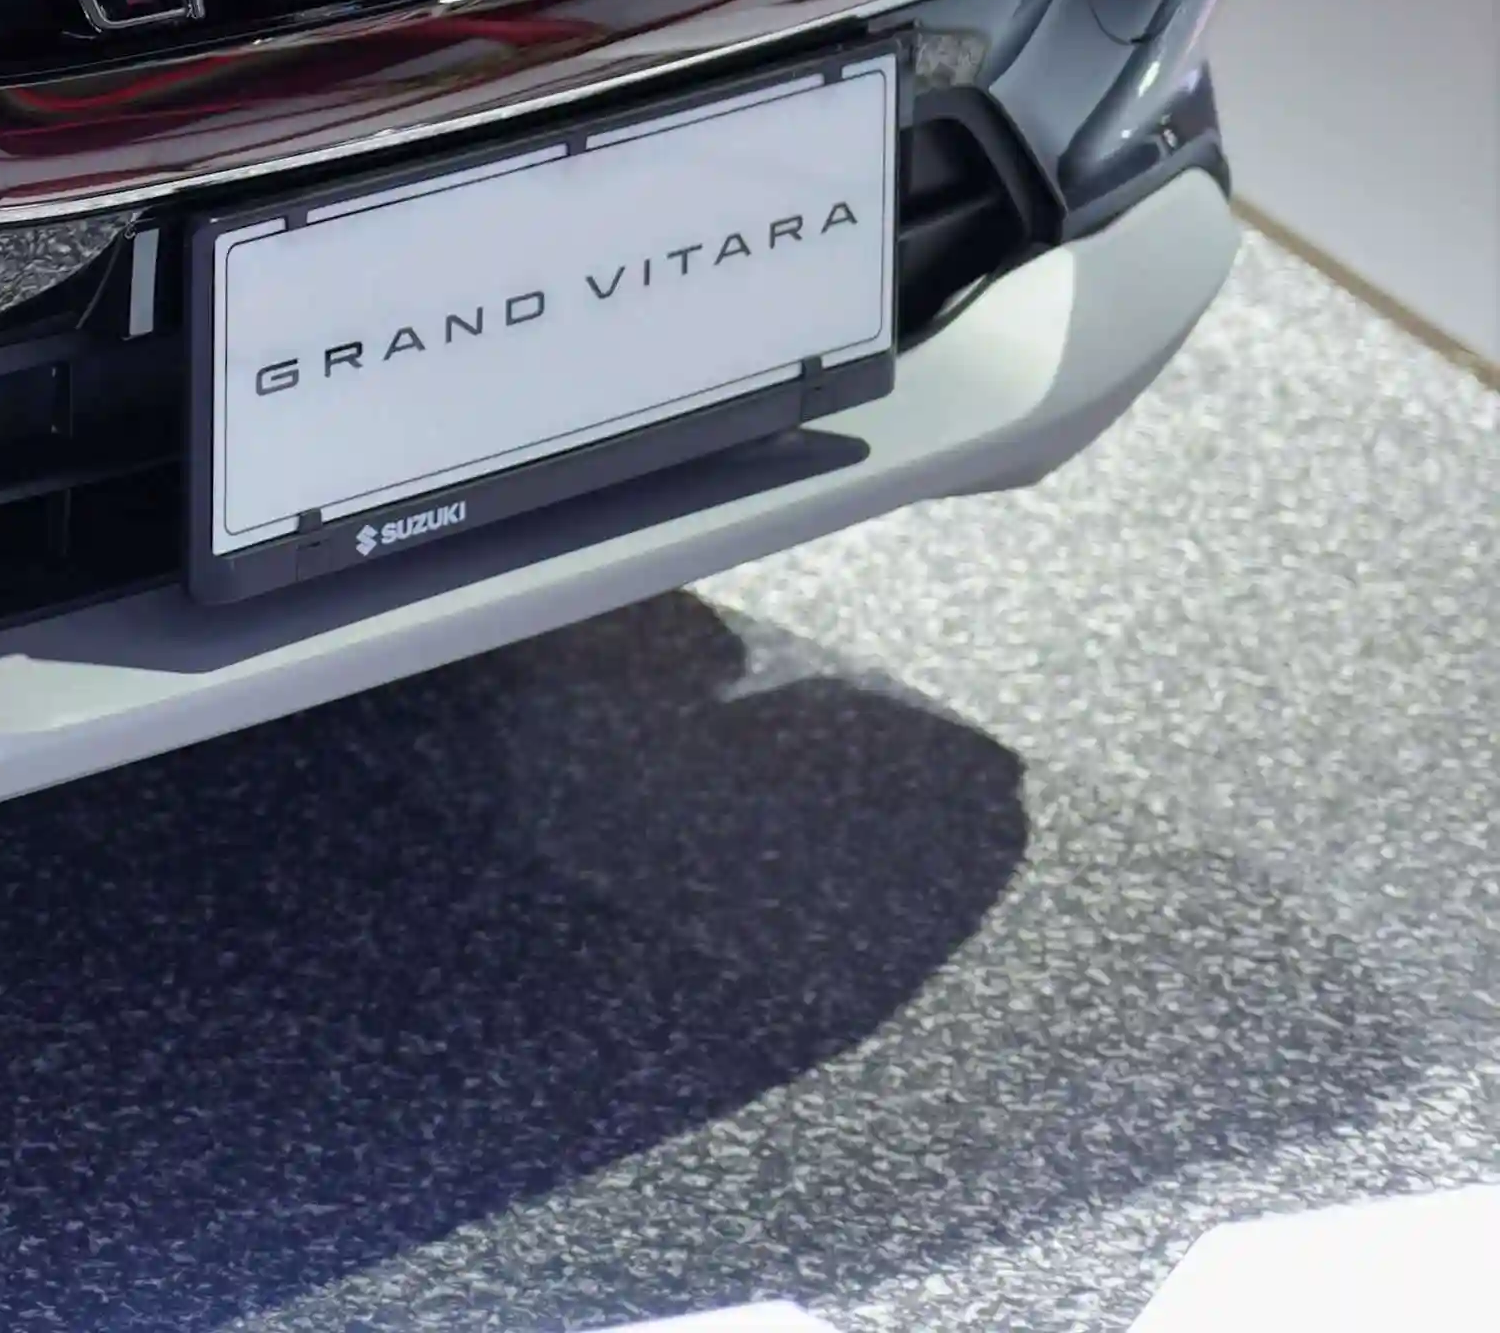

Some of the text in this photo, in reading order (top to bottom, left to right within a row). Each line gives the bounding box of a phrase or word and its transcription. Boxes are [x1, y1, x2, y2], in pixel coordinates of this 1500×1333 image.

[254, 199, 860, 397] GRAND VITARA
[380, 500, 466, 546] SUZUKI
